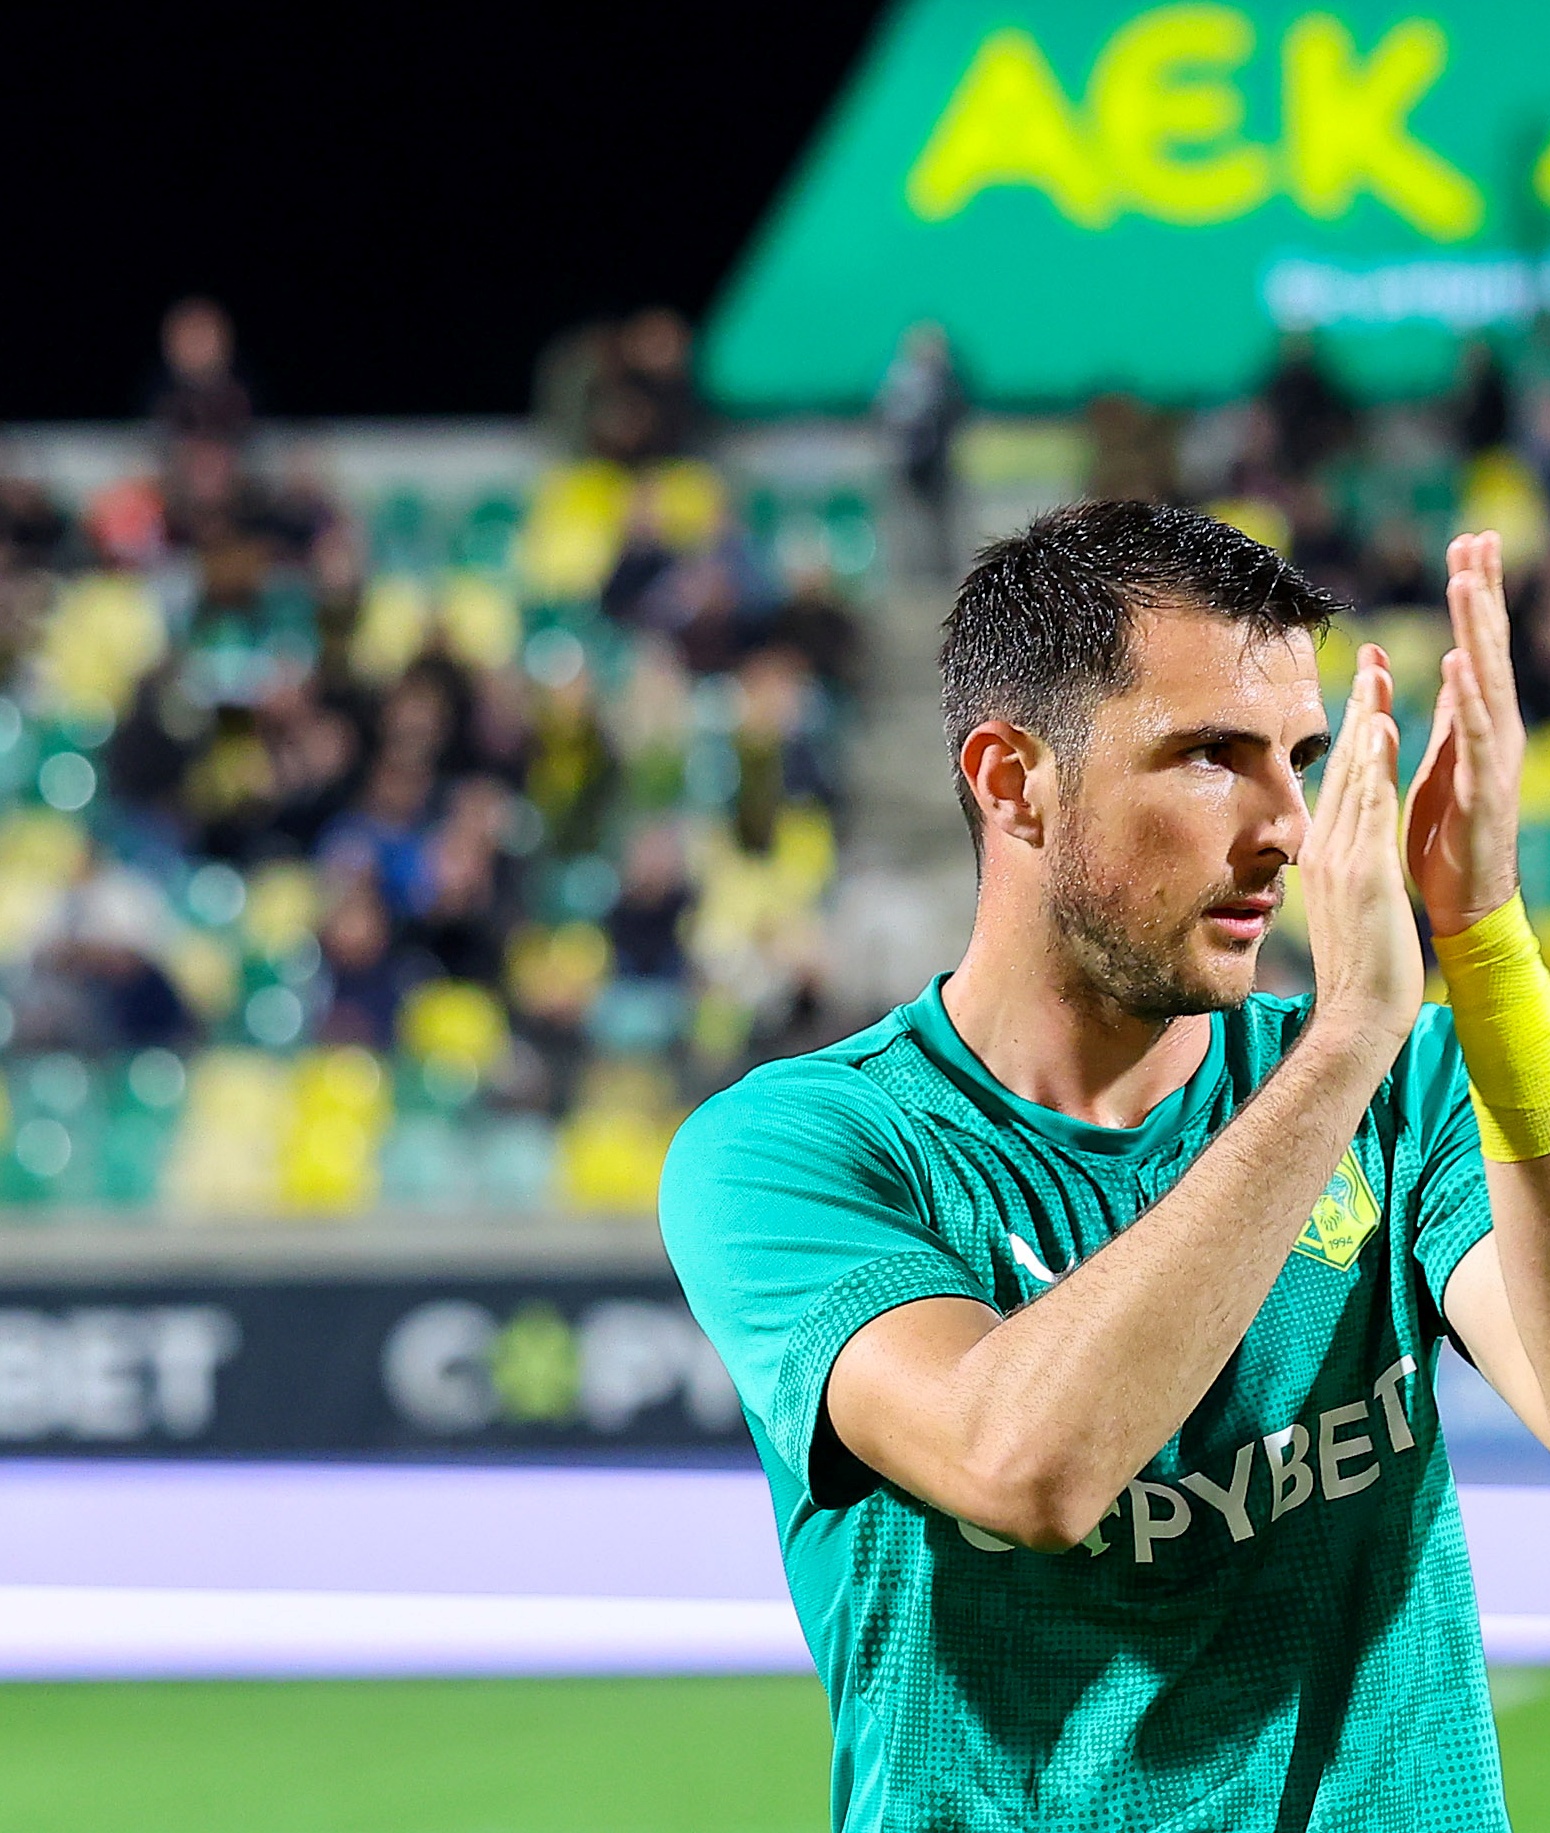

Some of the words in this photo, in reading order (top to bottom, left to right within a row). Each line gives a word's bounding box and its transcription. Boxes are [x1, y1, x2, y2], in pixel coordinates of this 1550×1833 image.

[906, 3, 1486, 242] AEK
[1328, 1236, 1353, 1250] 1994
[957, 1354, 1417, 1563] PYBET
